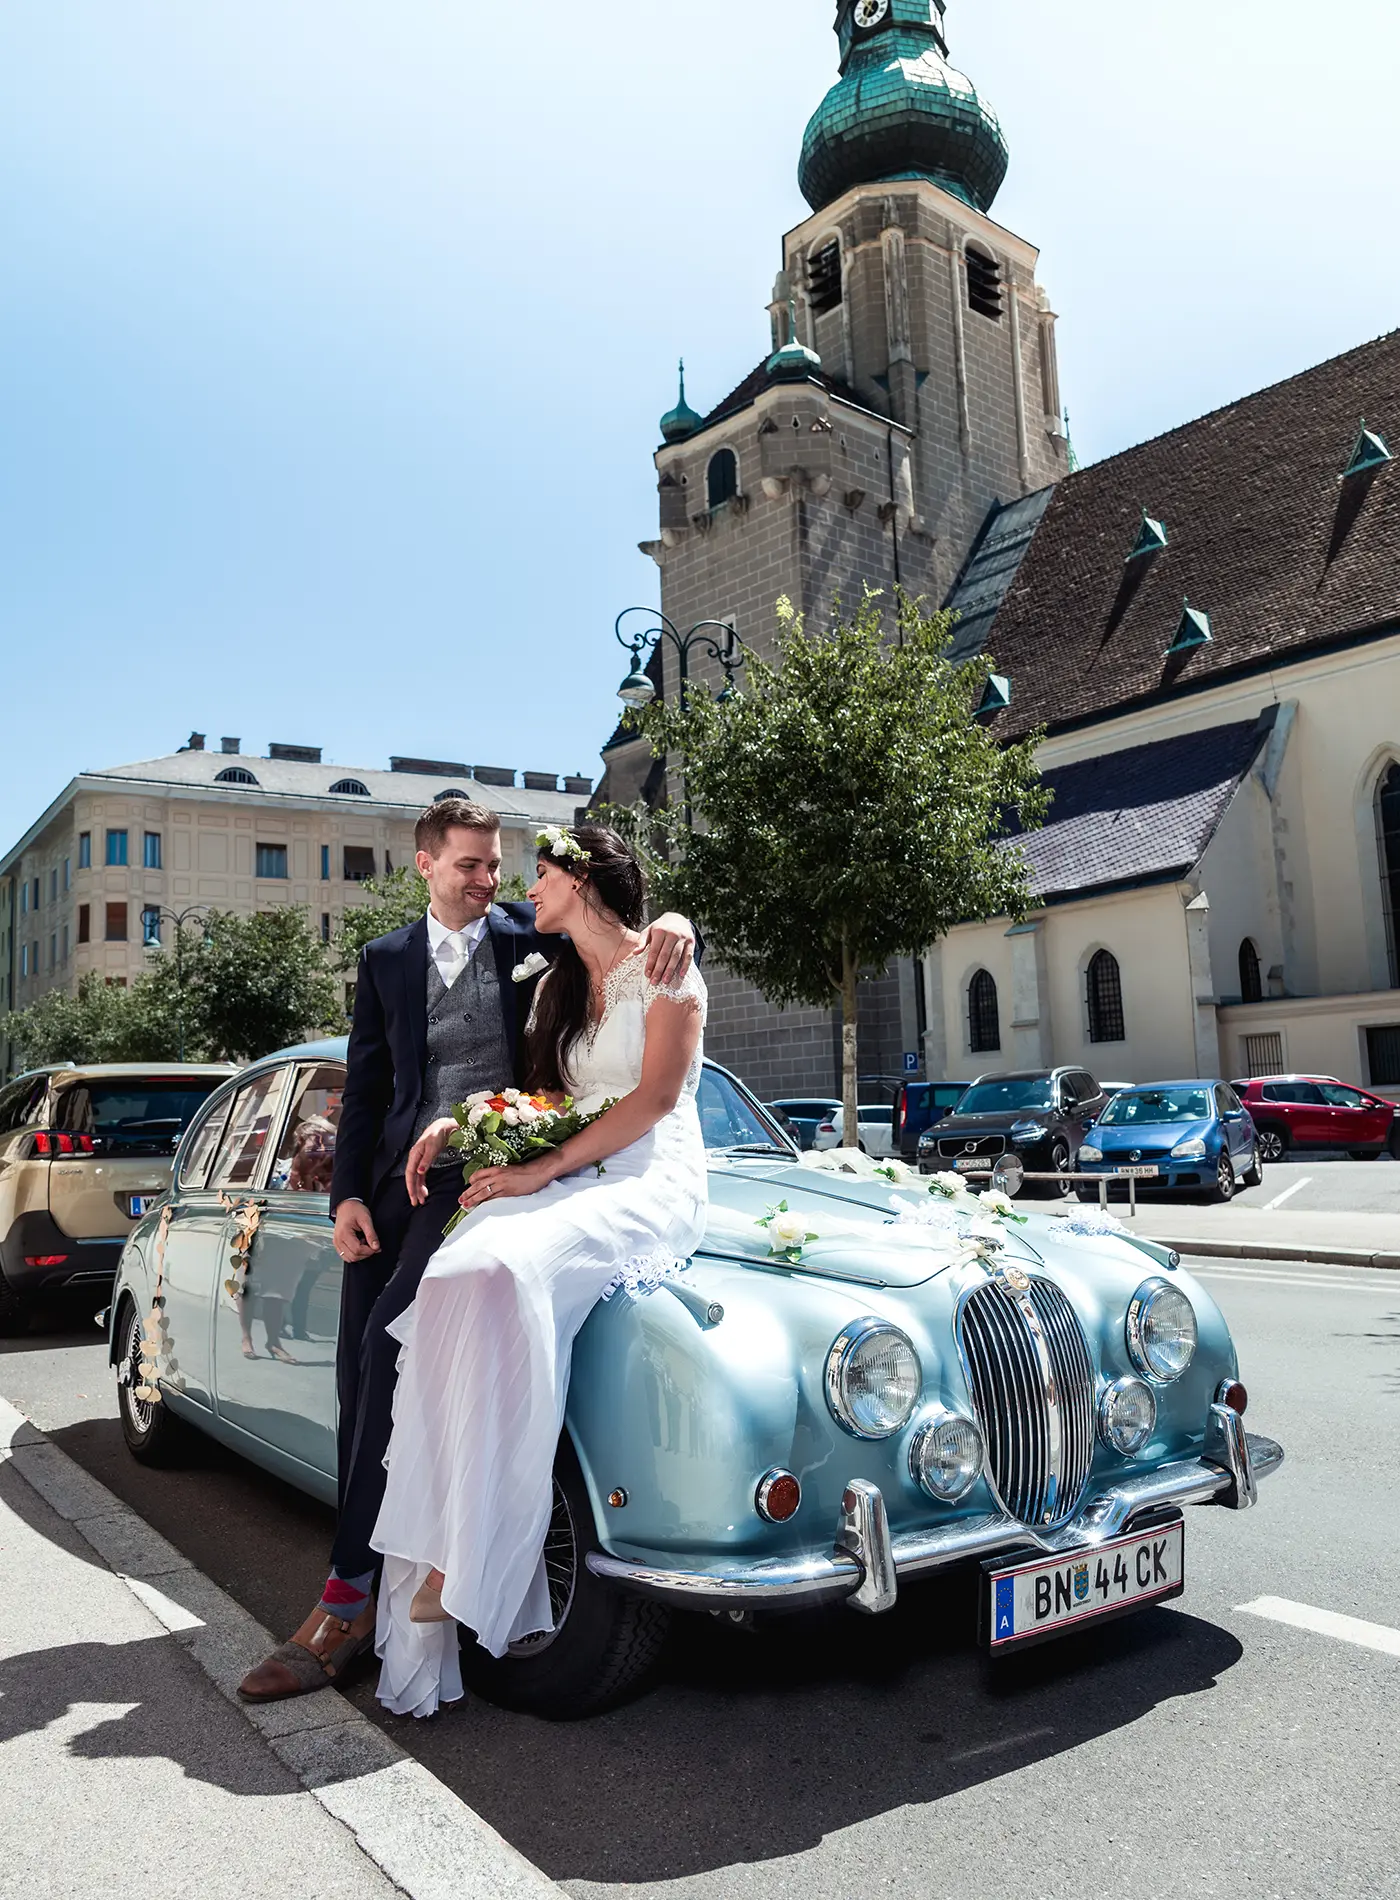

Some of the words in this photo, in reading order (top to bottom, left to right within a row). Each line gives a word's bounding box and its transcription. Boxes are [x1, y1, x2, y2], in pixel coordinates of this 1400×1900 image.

[906, 1054, 915, 1069] P
[1035, 1567, 1071, 1620] BN
[1095, 1553, 1128, 1599] 44
[1136, 1539, 1167, 1588] CK
[1000, 1615, 1009, 1630] A
